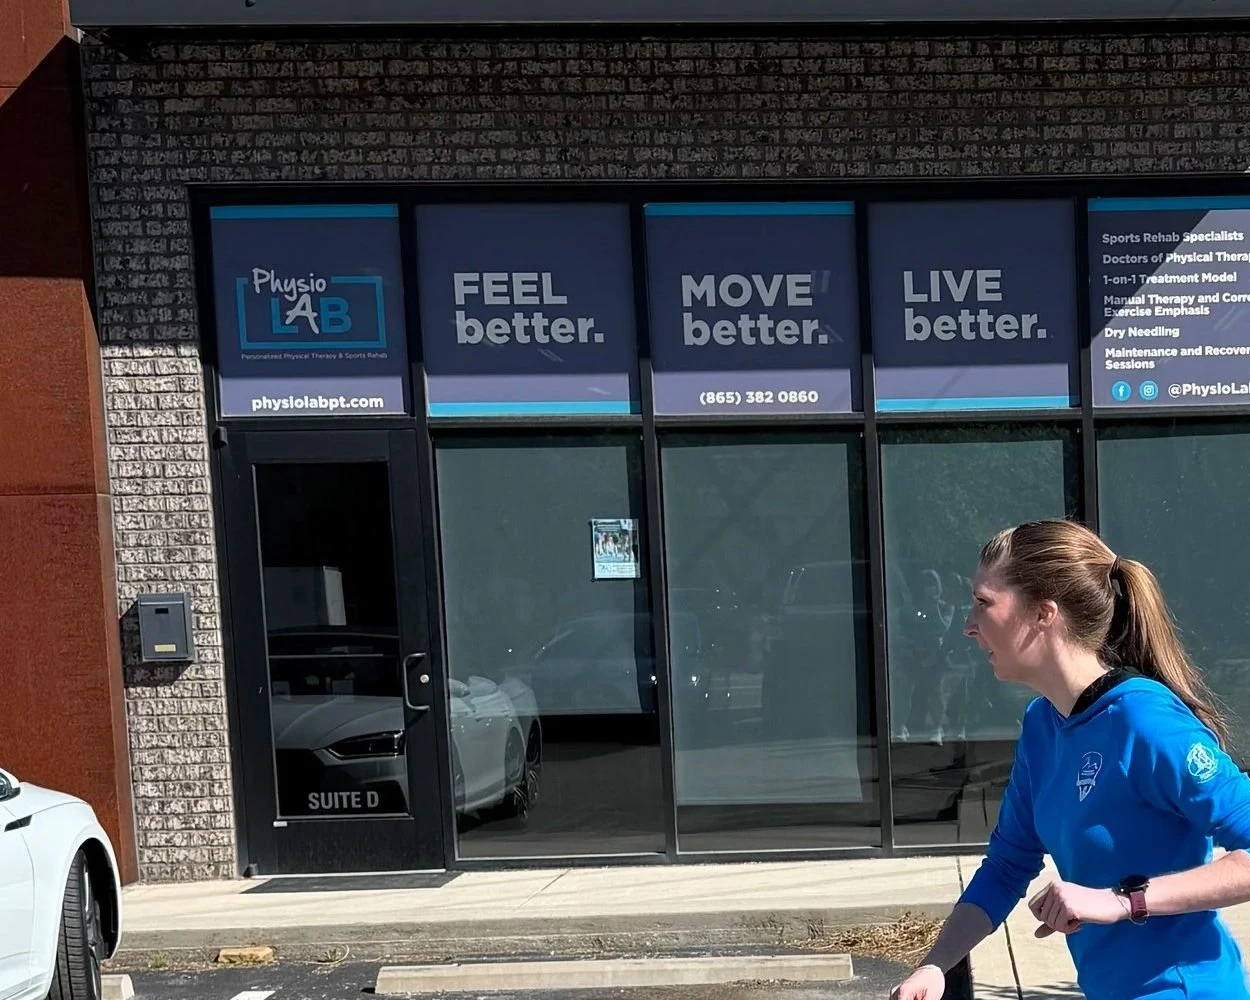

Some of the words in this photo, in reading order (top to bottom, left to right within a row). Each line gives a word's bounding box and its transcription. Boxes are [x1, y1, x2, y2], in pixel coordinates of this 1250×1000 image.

[1102, 233, 1141, 245] Sports
[1143, 232, 1180, 243] Rehab
[1182, 230, 1245, 243] Specialists
[1103, 254, 1149, 264] Doctors
[1151, 253, 1164, 263] of
[1165, 252, 1213, 264] Physical
[252, 267, 327, 302] Physio
[1103, 275, 1137, 284] 1-on-1
[1139, 274, 1199, 284] Treatment
[1201, 272, 1238, 282] Model
[453, 272, 568, 305] FEEL
[681, 274, 813, 307] MOVE
[902, 269, 1003, 303] LIVE
[1104, 295, 1145, 305] Manual
[1147, 293, 1195, 305] Therapy
[1197, 293, 1220, 303] and
[270, 293, 352, 335] LAB
[1104, 307, 1151, 317] Exercise
[1154, 305, 1210, 317] Emphasis
[454, 310, 605, 344] better.
[681, 312, 829, 346] better.
[903, 308, 1048, 341] better.
[1104, 327, 1126, 339] Dry
[1128, 326, 1180, 338] Needling
[1105, 347, 1178, 358] Maintenance
[1180, 347, 1203, 356] and
[1105, 359, 1156, 370] Sessions
[252, 396, 384, 411] physiolabpt.com
[699, 391, 742, 405] (865)
[745, 391, 774, 404] 382
[777, 391, 819, 403] 0860
[308, 792, 362, 809] SUITE
[366, 791, 379, 808] D
